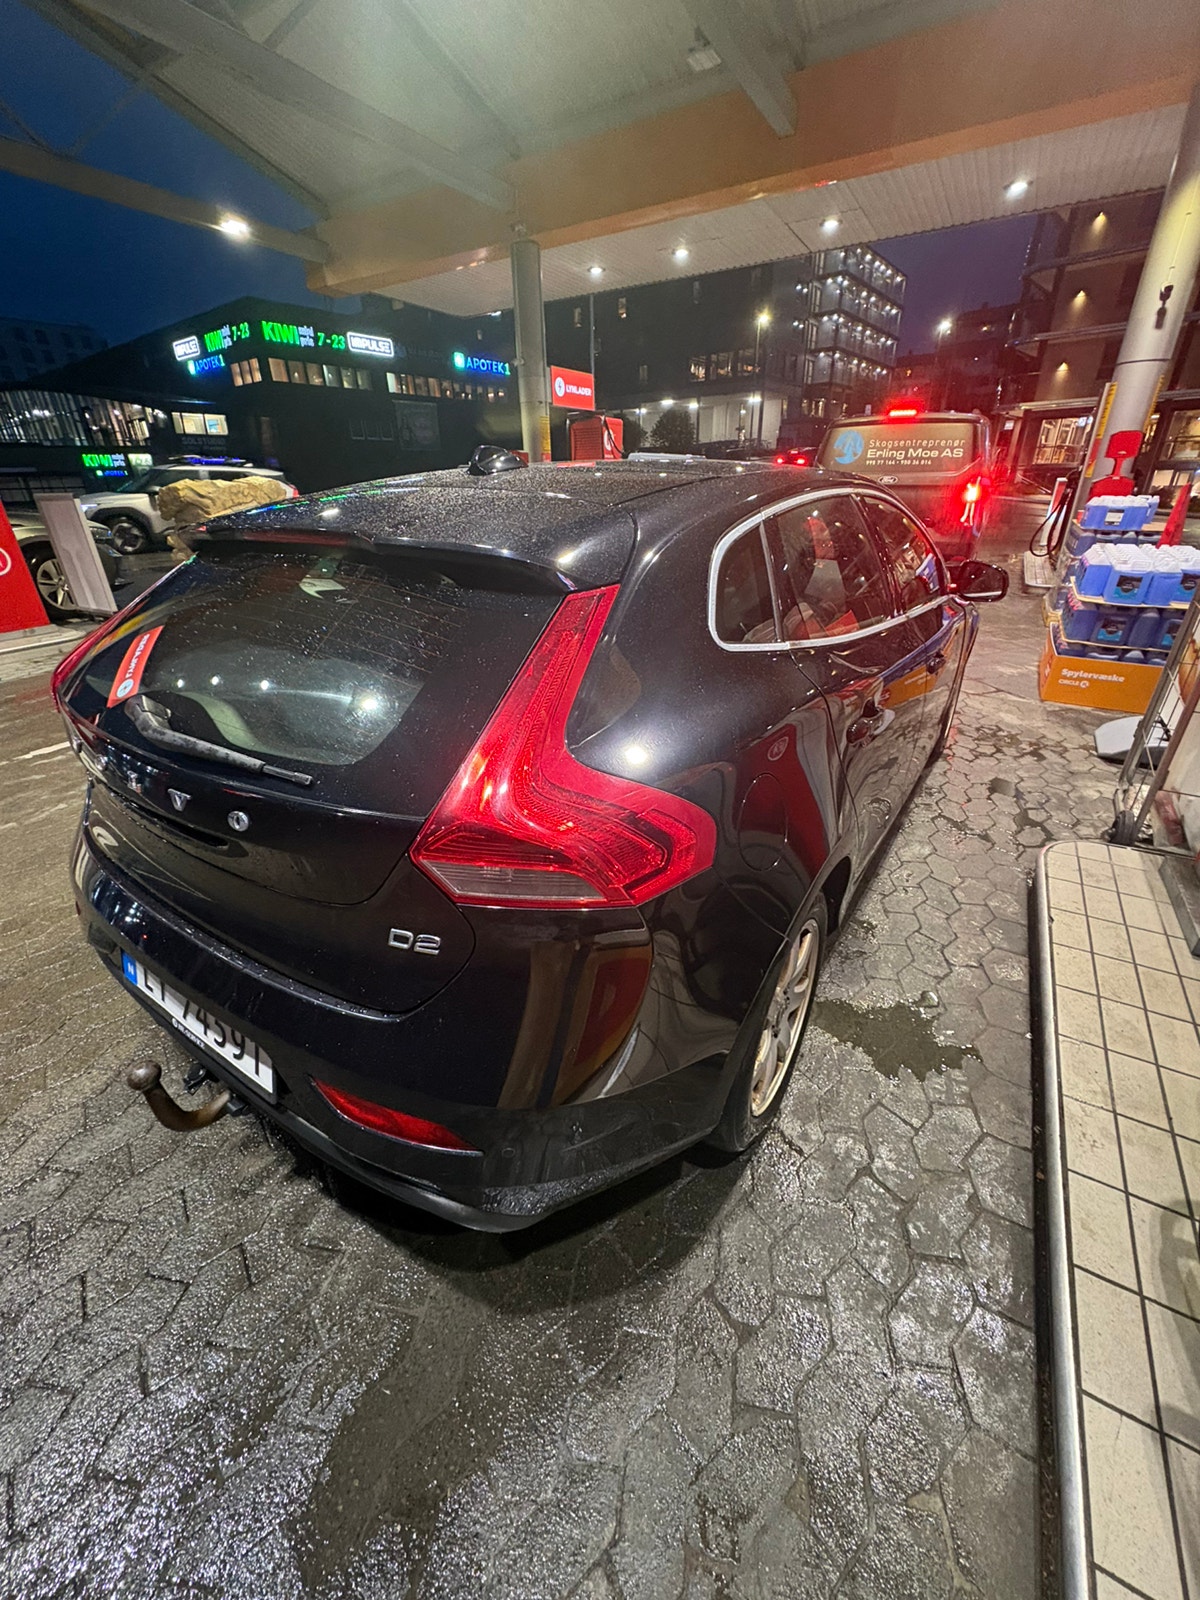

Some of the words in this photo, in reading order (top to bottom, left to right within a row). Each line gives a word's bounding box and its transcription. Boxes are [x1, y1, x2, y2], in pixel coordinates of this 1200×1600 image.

[261, 320, 300, 345] KIWI
[204, 329, 225, 352] KIWI
[869, 439, 965, 448] Skogsentreprenør
[82, 453, 113, 467] KIWI
[867, 449, 905, 459] Erling
[908, 448, 939, 458] Moe
[941, 448, 964, 458] AS
[1061, 668, 1125, 682] Spylervæske
[387, 927, 441, 956] D2
[127, 961, 135, 976] N
